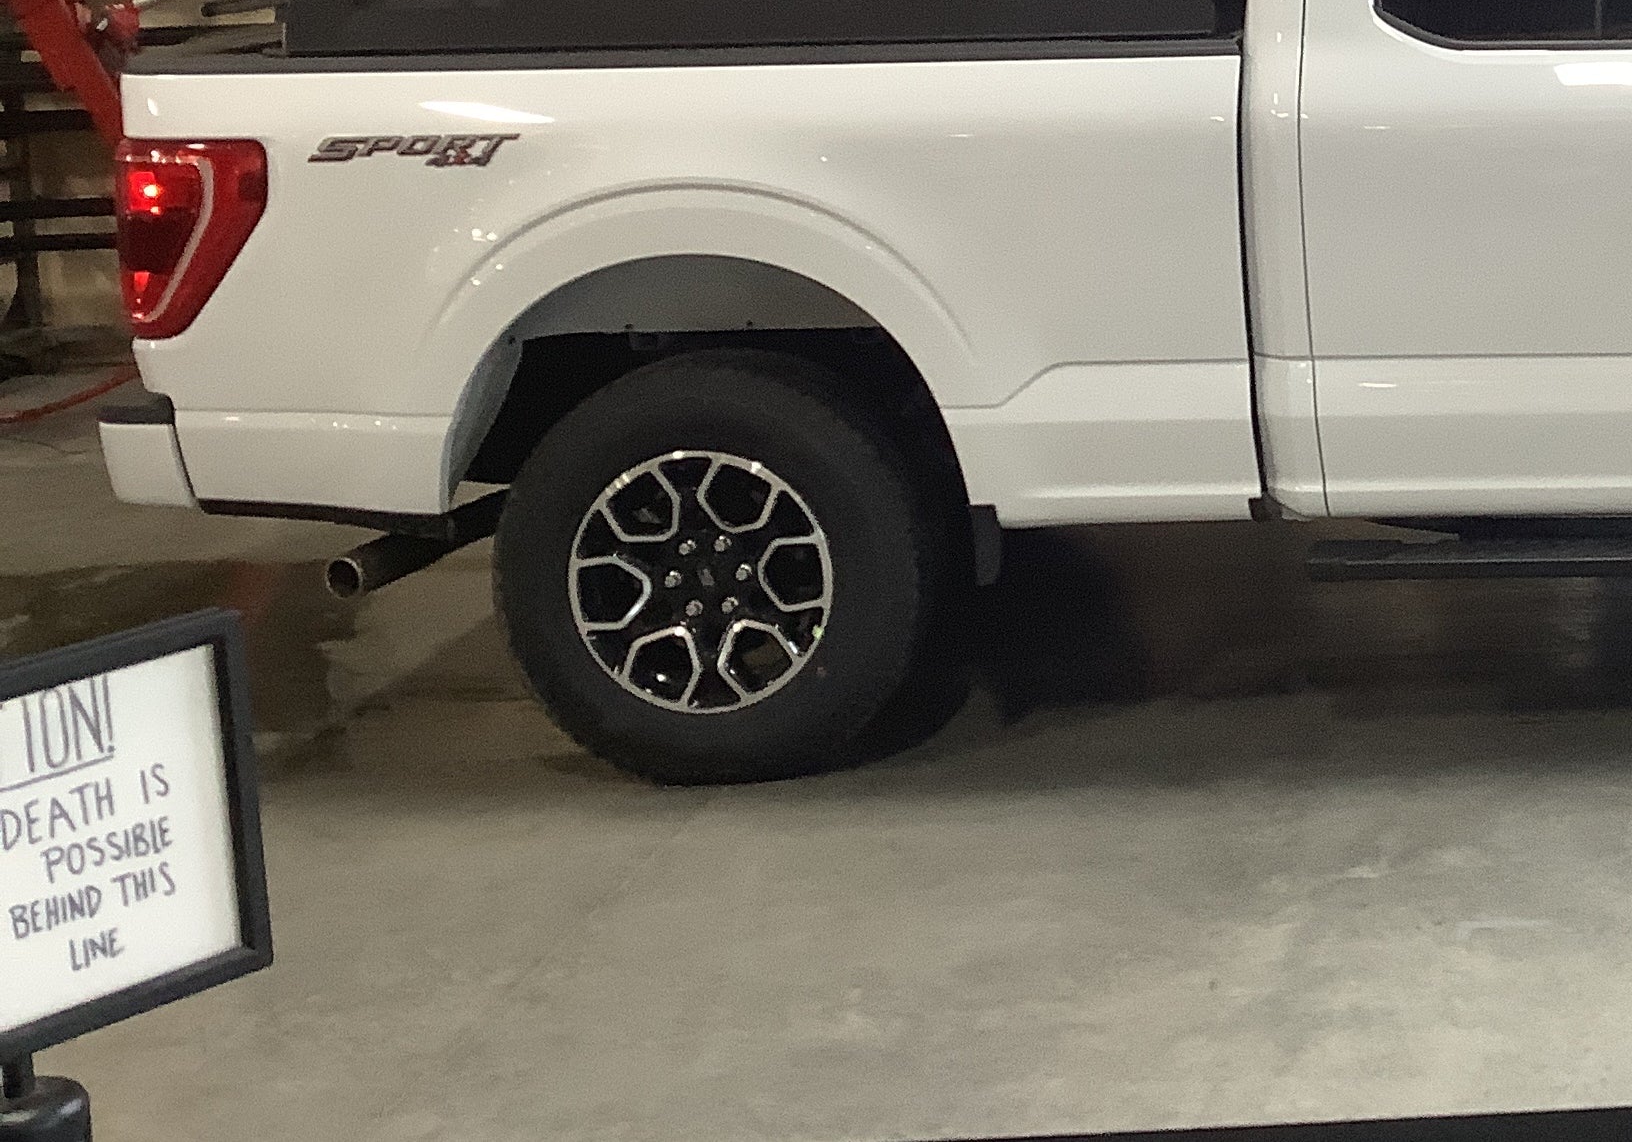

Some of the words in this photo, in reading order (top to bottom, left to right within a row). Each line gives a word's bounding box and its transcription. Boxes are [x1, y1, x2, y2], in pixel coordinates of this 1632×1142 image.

[307, 133, 520, 165] SPORT
[0, 675, 116, 772] ION!
[0, 778, 115, 850] DEATH
[141, 764, 170, 804] IS
[43, 816, 174, 883] POSSIBLE
[9, 885, 103, 939] BEHIND
[112, 861, 175, 908] THIS
[70, 927, 125, 972] LINE
